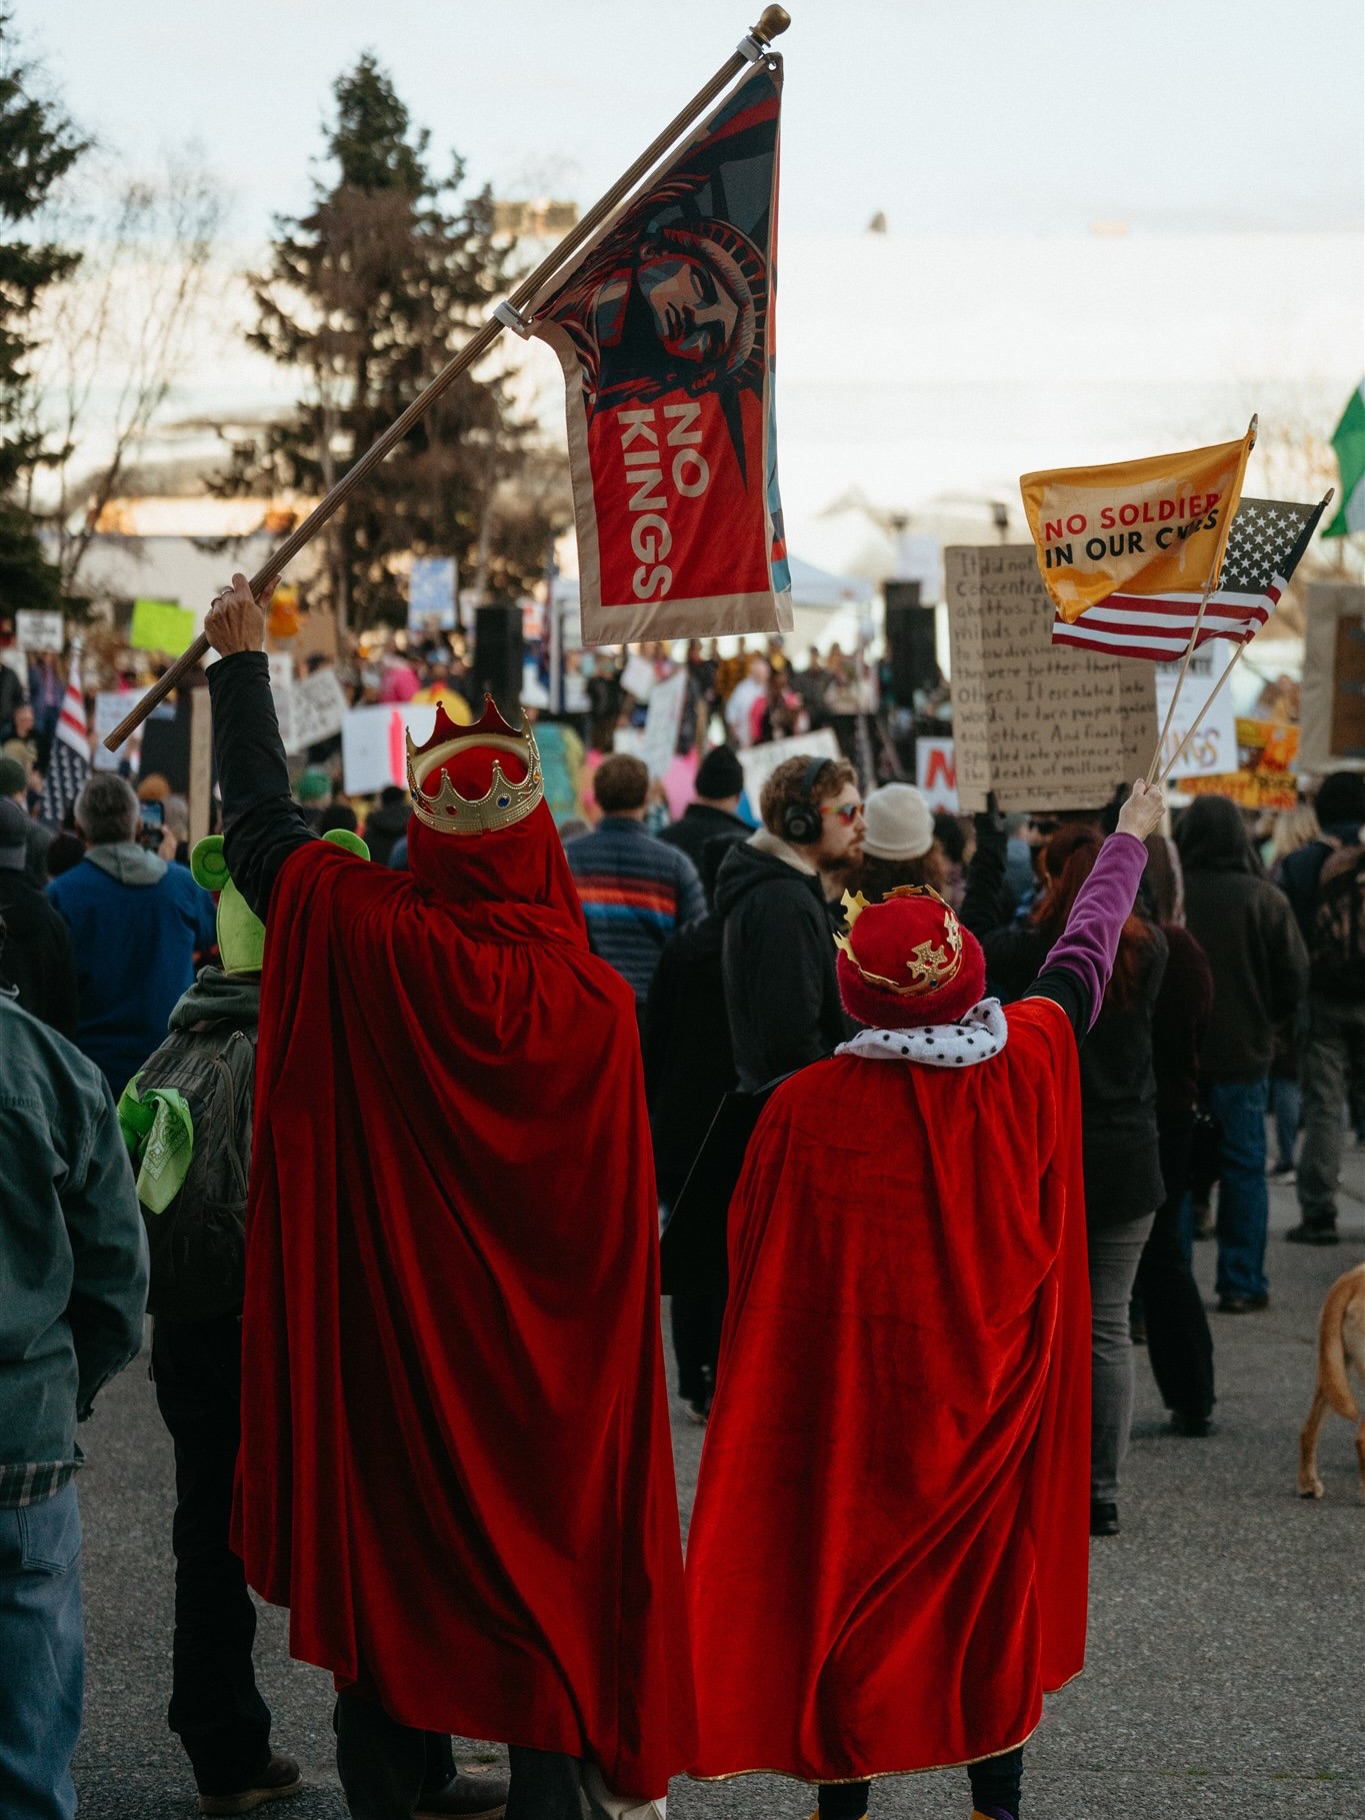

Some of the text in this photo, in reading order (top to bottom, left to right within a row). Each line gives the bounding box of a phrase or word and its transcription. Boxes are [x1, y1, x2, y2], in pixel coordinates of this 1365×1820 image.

[663, 402, 710, 498] NO
[617, 408, 673, 600] KINGS
[1045, 493, 1222, 542] NO SOLDIER
[1046, 543, 1073, 569] IN
[1086, 531, 1145, 561] OUR
